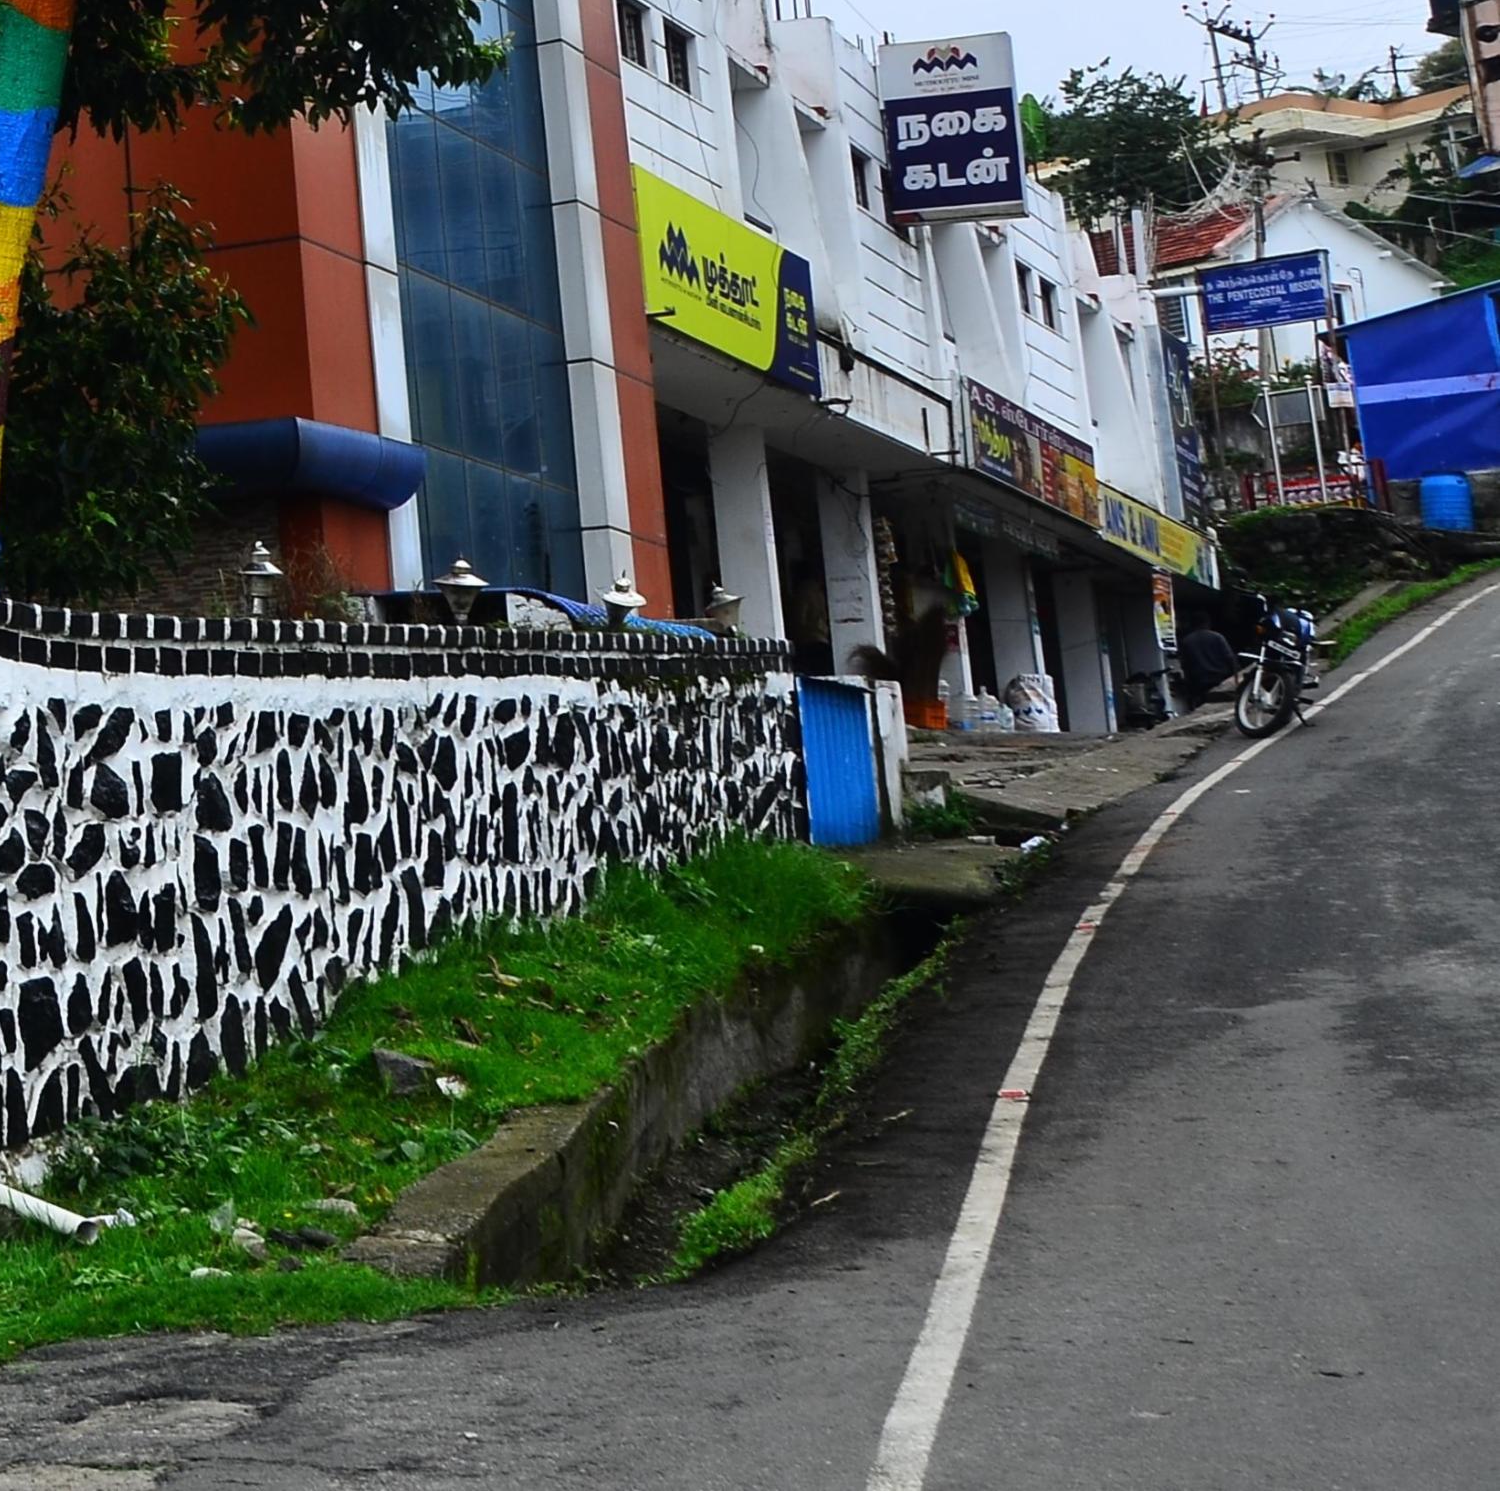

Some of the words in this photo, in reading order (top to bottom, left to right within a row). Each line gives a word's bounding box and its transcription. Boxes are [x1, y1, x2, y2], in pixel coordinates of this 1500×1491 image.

[897, 106, 1007, 150] நகை
[903, 147, 1010, 191] கடன்
[1207, 291, 1225, 305] THE
[1227, 284, 1288, 303] PENTECOSTAL
